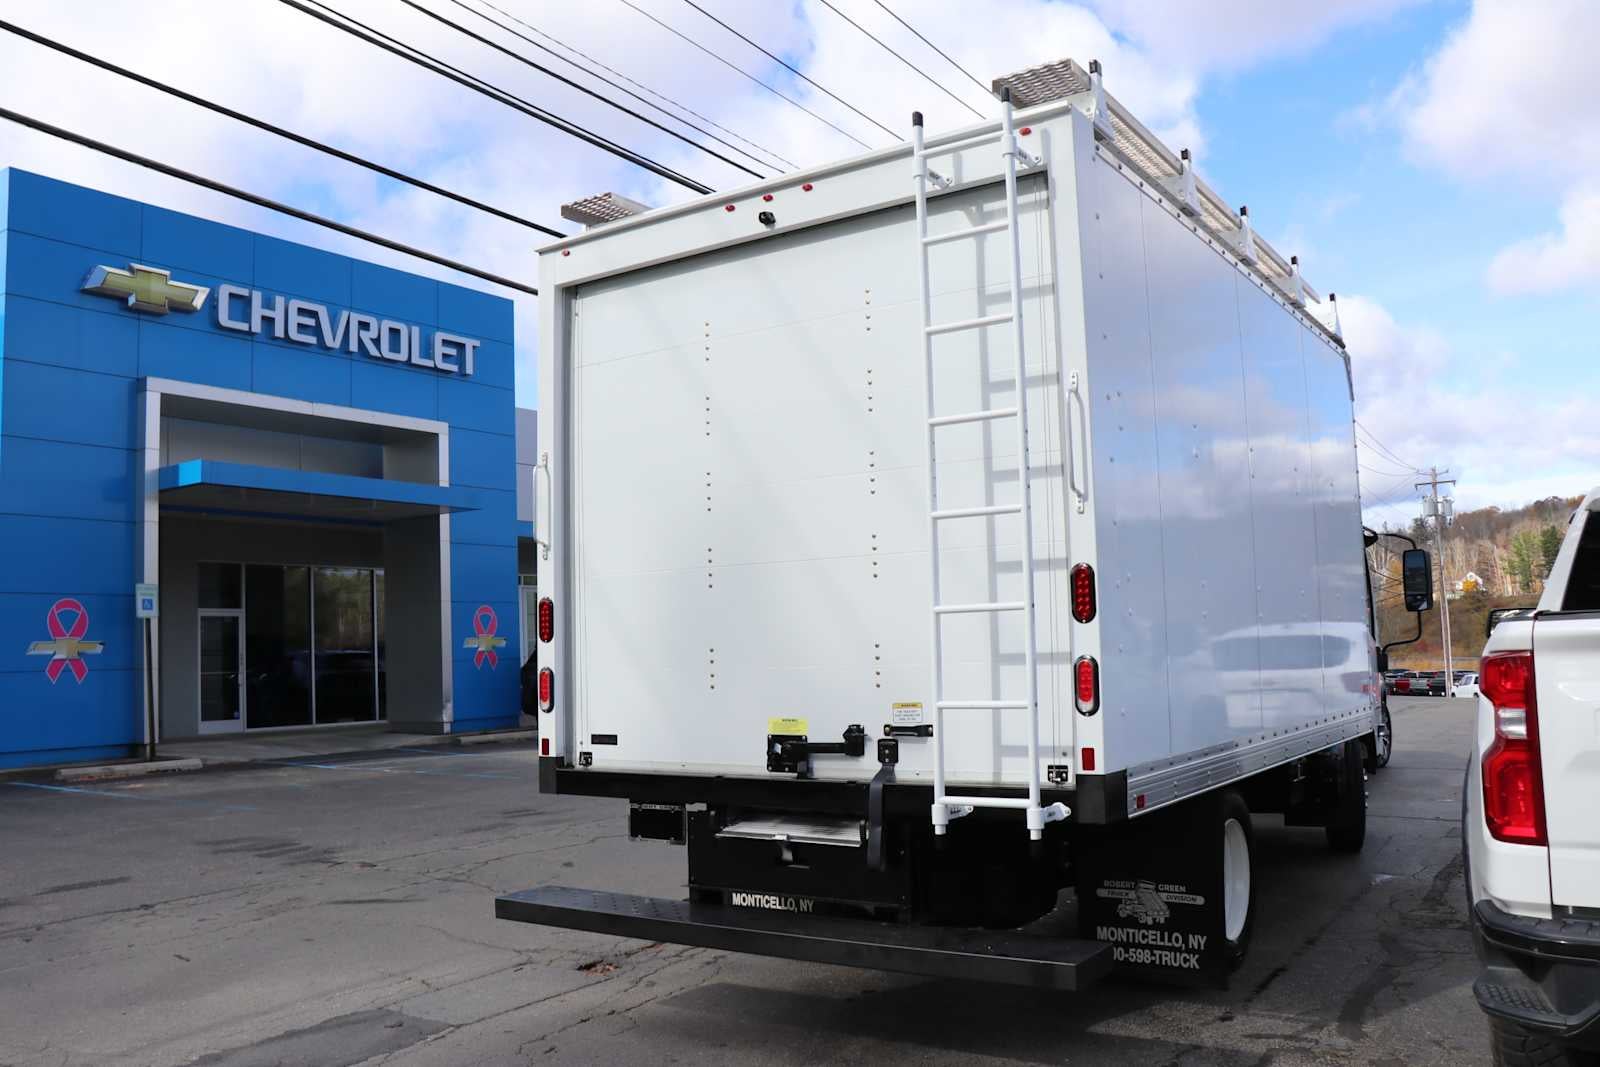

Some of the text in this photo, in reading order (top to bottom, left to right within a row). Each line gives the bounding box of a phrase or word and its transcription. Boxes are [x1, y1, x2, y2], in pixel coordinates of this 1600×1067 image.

[218, 283, 480, 375] CHEVROLET
[1104, 880, 1186, 893] ROBERT GREEN
[732, 892, 815, 913] MONTICELLO, NY
[1166, 894, 1198, 903] DIVISION
[1096, 926, 1207, 950] MONTICELLO, NY
